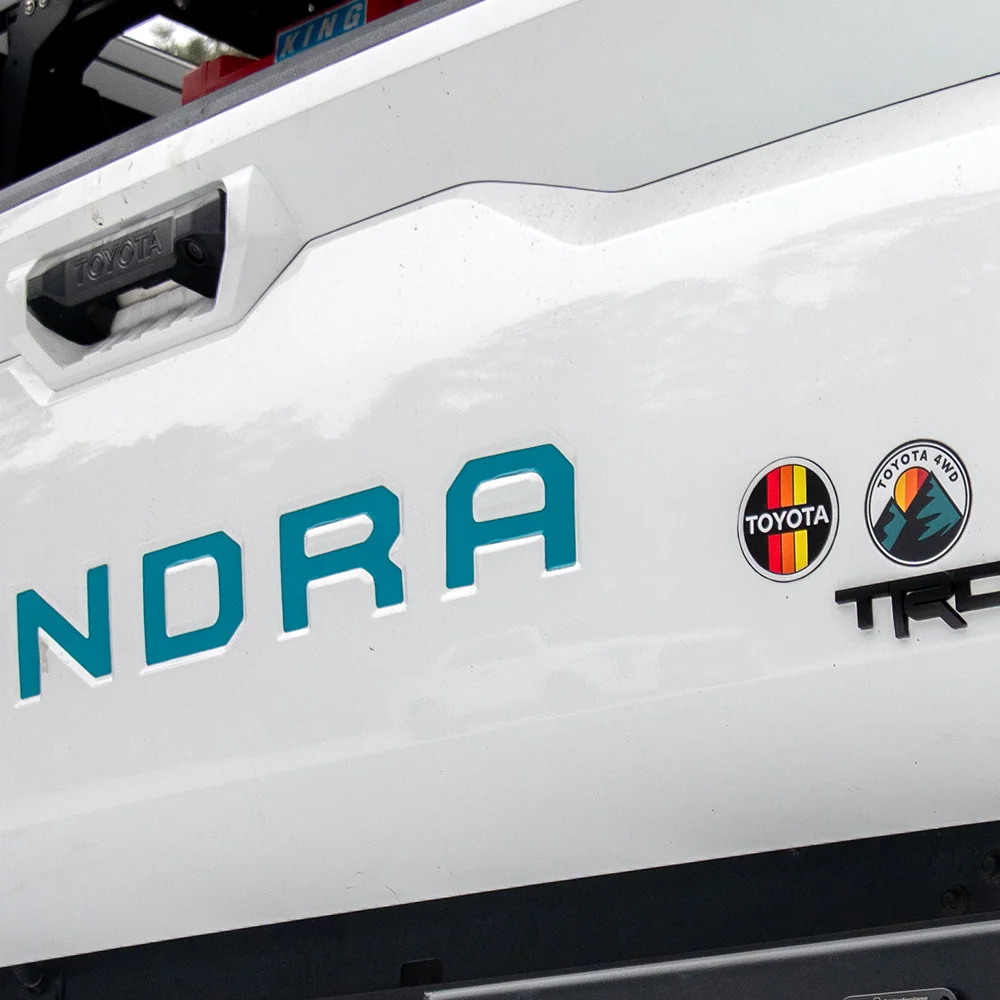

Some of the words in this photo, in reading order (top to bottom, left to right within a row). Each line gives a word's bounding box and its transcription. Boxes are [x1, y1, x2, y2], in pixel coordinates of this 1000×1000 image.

[281, 3, 363, 57] KING
[74, 229, 164, 286] TOYOTA
[877, 449, 928, 489] TOYOTA
[933, 454, 959, 483] 4WD
[745, 505, 830, 535] TOYOTA
[16, 444, 578, 700] NDRA
